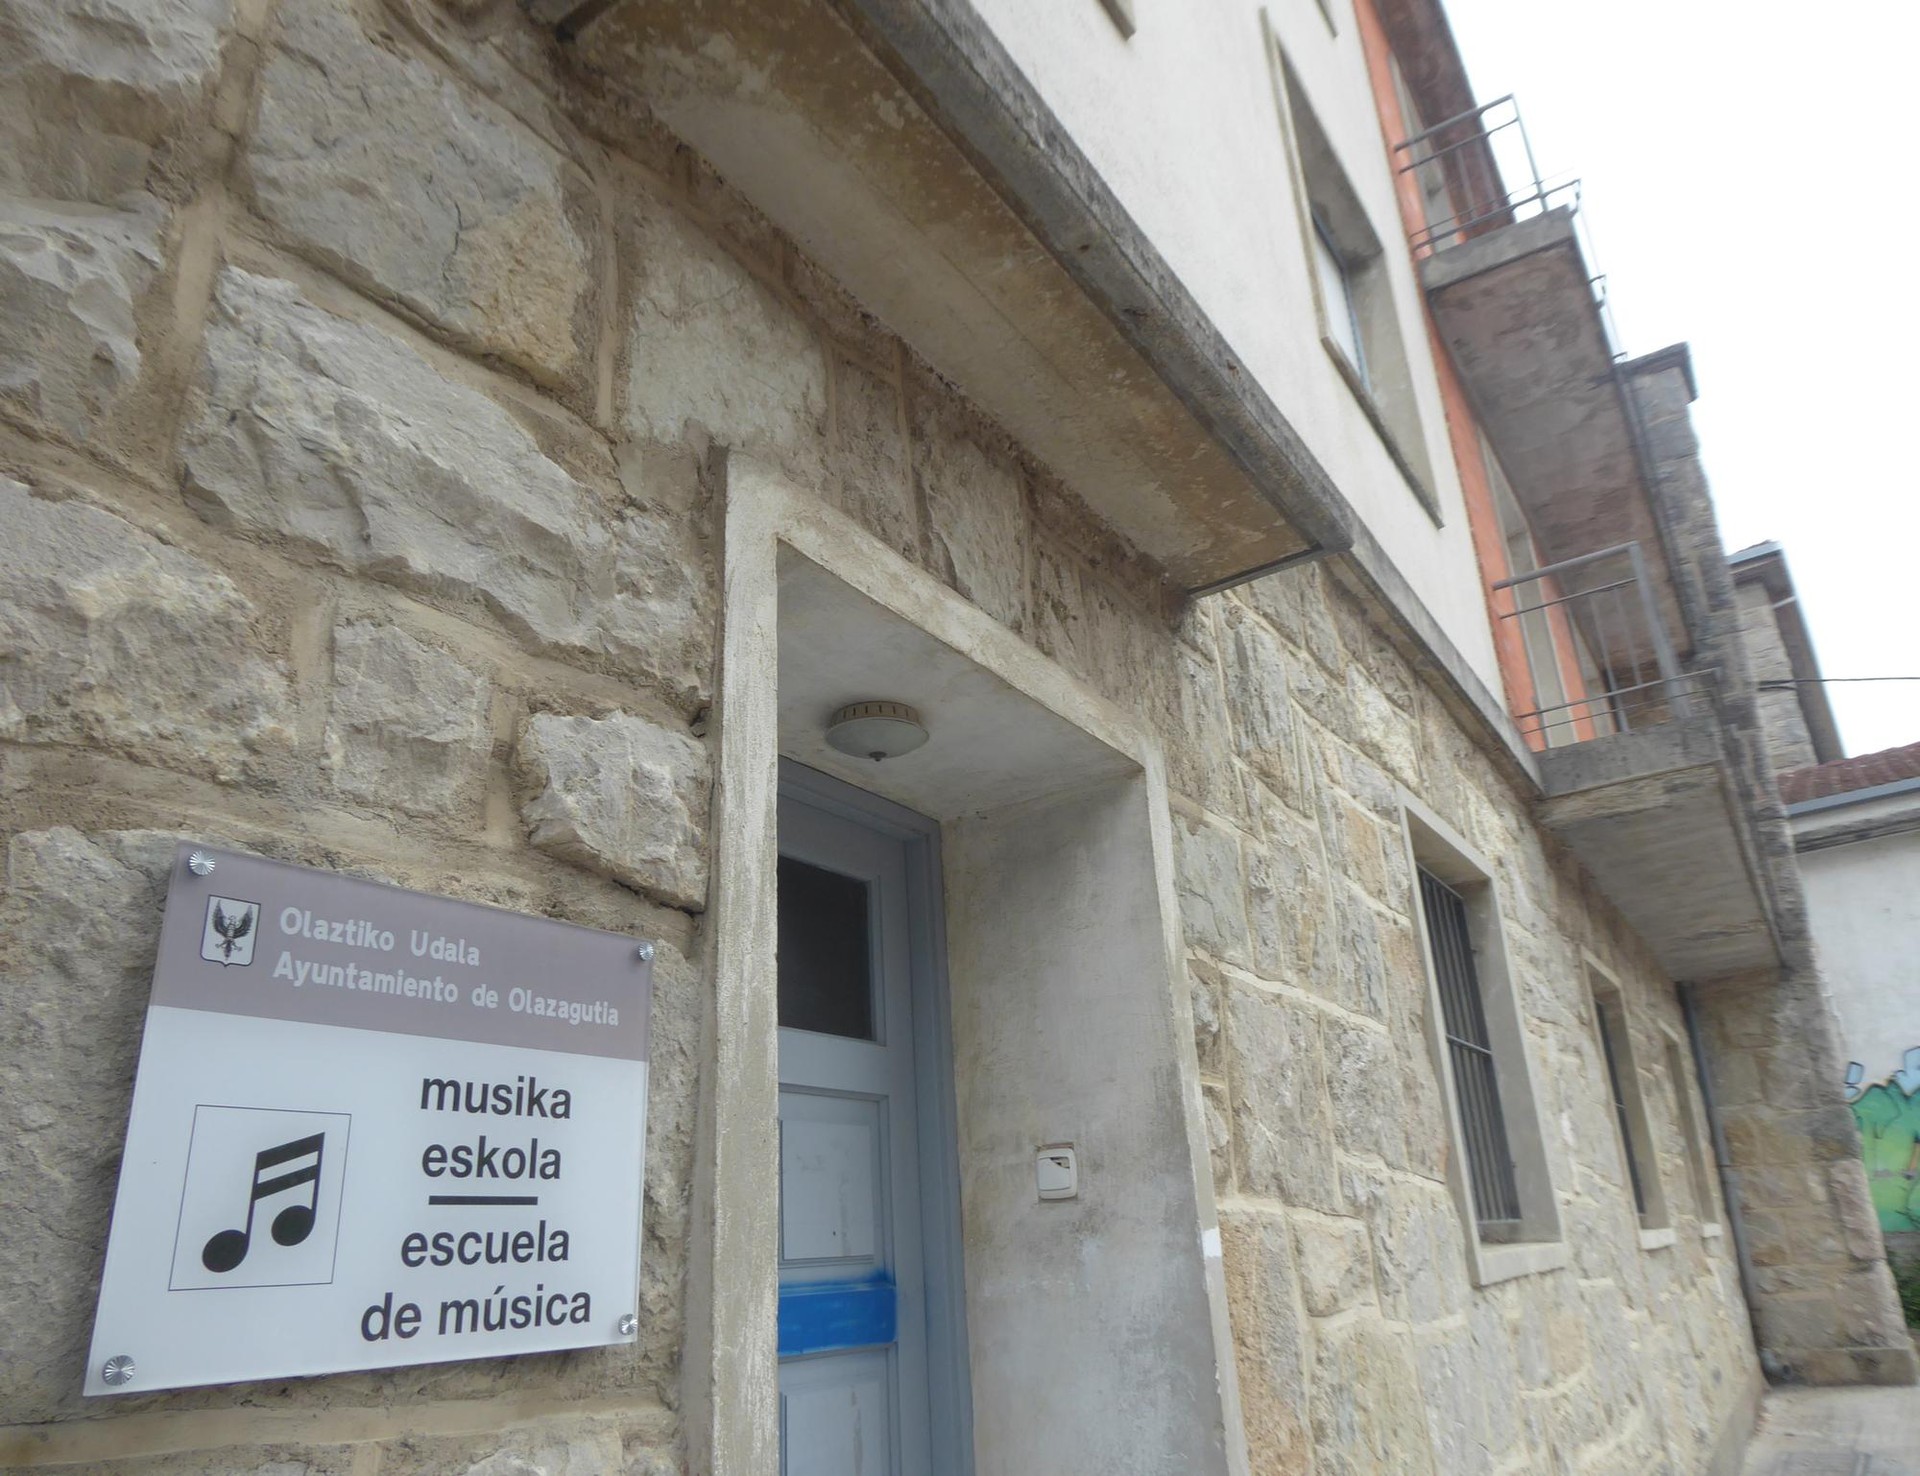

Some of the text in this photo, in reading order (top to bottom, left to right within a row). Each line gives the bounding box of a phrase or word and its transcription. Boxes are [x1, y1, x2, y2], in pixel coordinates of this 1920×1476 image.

[280, 907, 480, 967] Olaztiko Udala
[273, 952, 619, 1026] Ayuntamiento de Olazagutia
[420, 1075, 572, 1119] musika
[421, 1135, 562, 1180] eskola
[400, 1220, 570, 1267] escuela
[360, 1284, 591, 1342] de música
